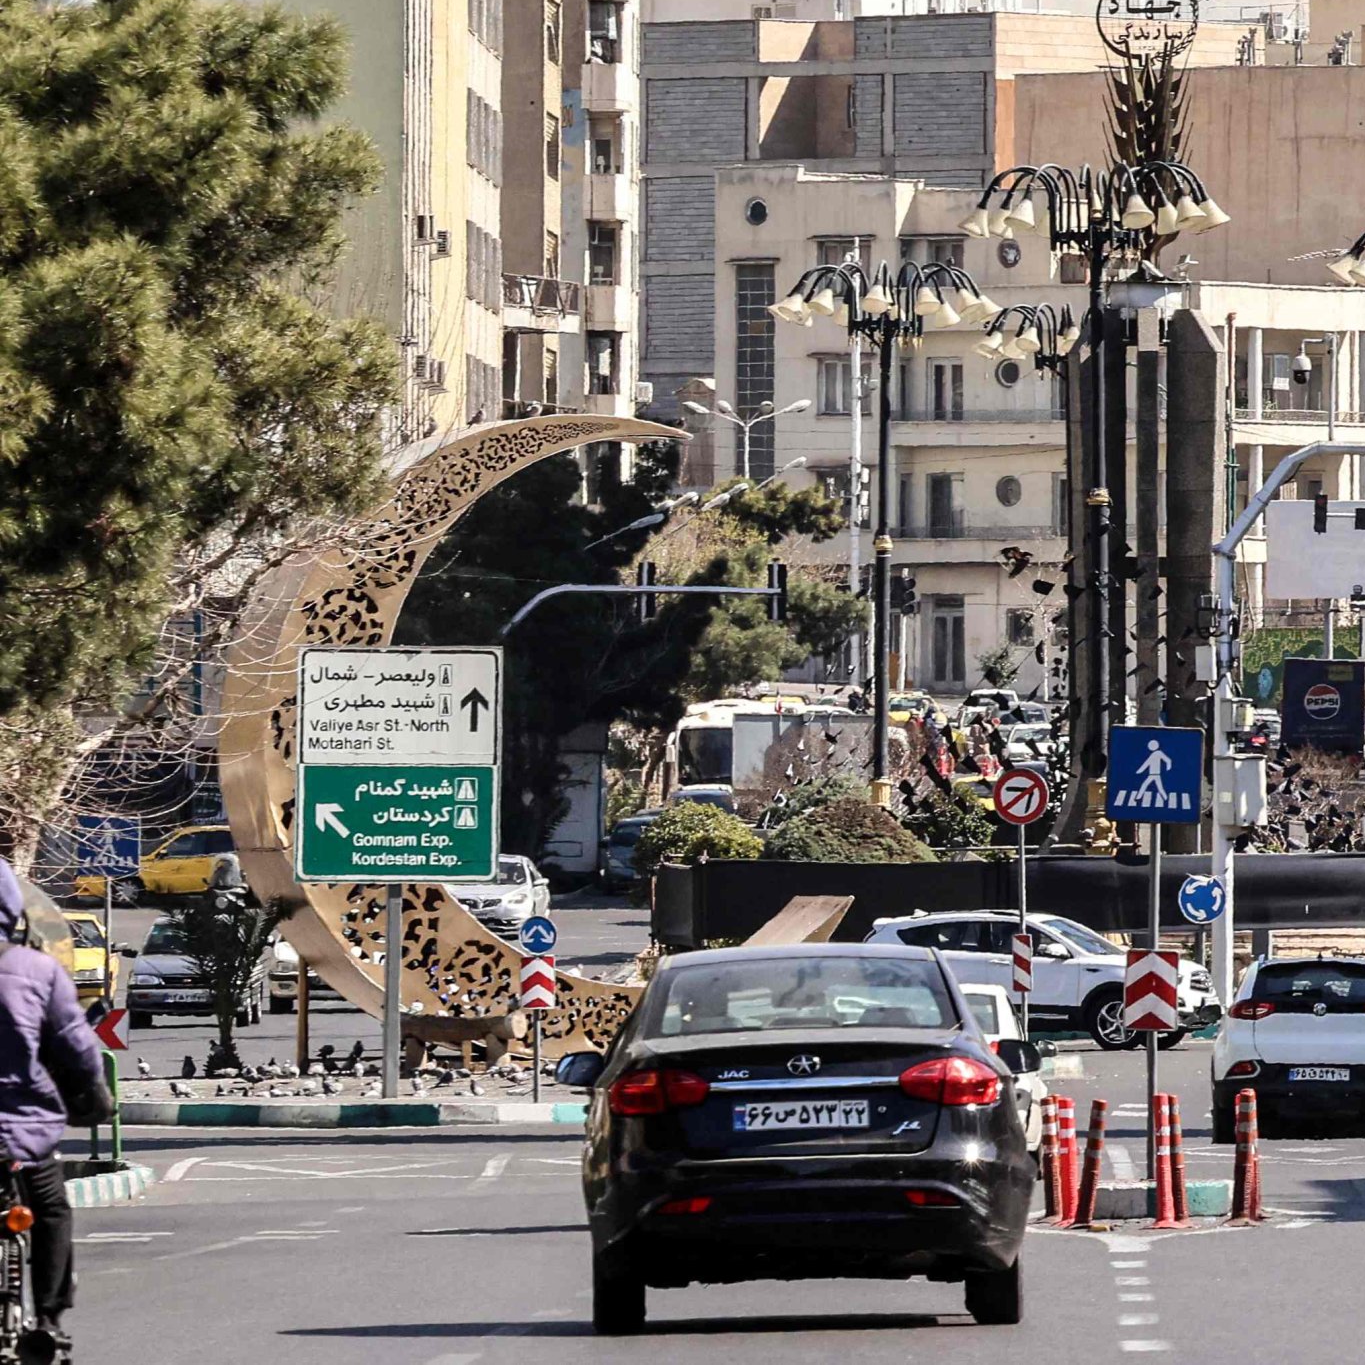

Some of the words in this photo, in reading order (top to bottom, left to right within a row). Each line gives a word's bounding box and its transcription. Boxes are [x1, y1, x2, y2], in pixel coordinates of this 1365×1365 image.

[1112, 21, 1183, 44] سازندگی
[310, 665, 358, 685] شمال
[324, 694, 385, 712] مطهری
[391, 693, 435, 713] شهید
[1306, 697, 1339, 706] PEPSI
[310, 720, 353, 734] Valiye
[356, 720, 380, 732] Asr
[308, 737, 372, 750] Motahari
[377, 737, 395, 750] St.
[355, 779, 406, 802] گمنام
[407, 779, 453, 797] شهید
[372, 807, 453, 824] کردستان
[353, 832, 417, 847] Gomnam
[421, 832, 453, 848] Exp.
[352, 852, 426, 865] Kordestan
[430, 852, 462, 867] Exp.
[717, 1070, 750, 1079] JAC
